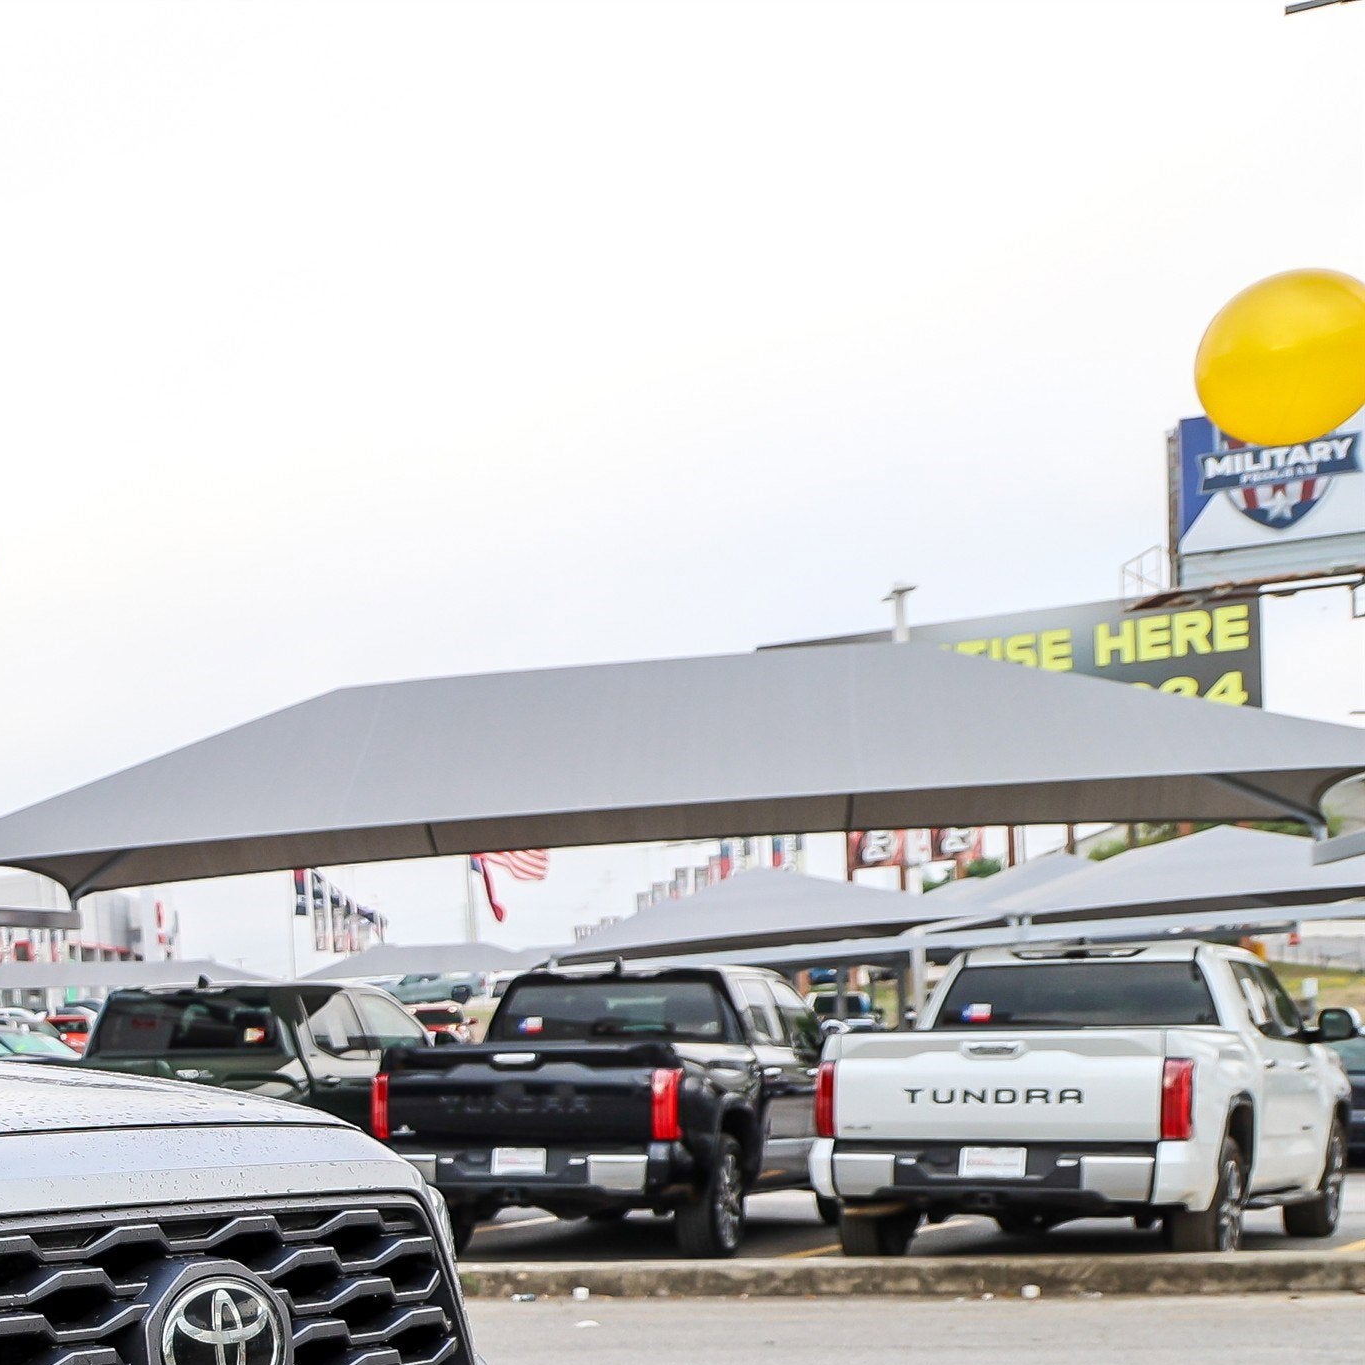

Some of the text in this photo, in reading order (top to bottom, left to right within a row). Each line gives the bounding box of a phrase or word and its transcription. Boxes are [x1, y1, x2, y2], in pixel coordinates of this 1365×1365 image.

[1204, 438, 1352, 477] MILITARY
[1094, 604, 1250, 667] HERE
[903, 1087, 1085, 1105] TUNDRA
